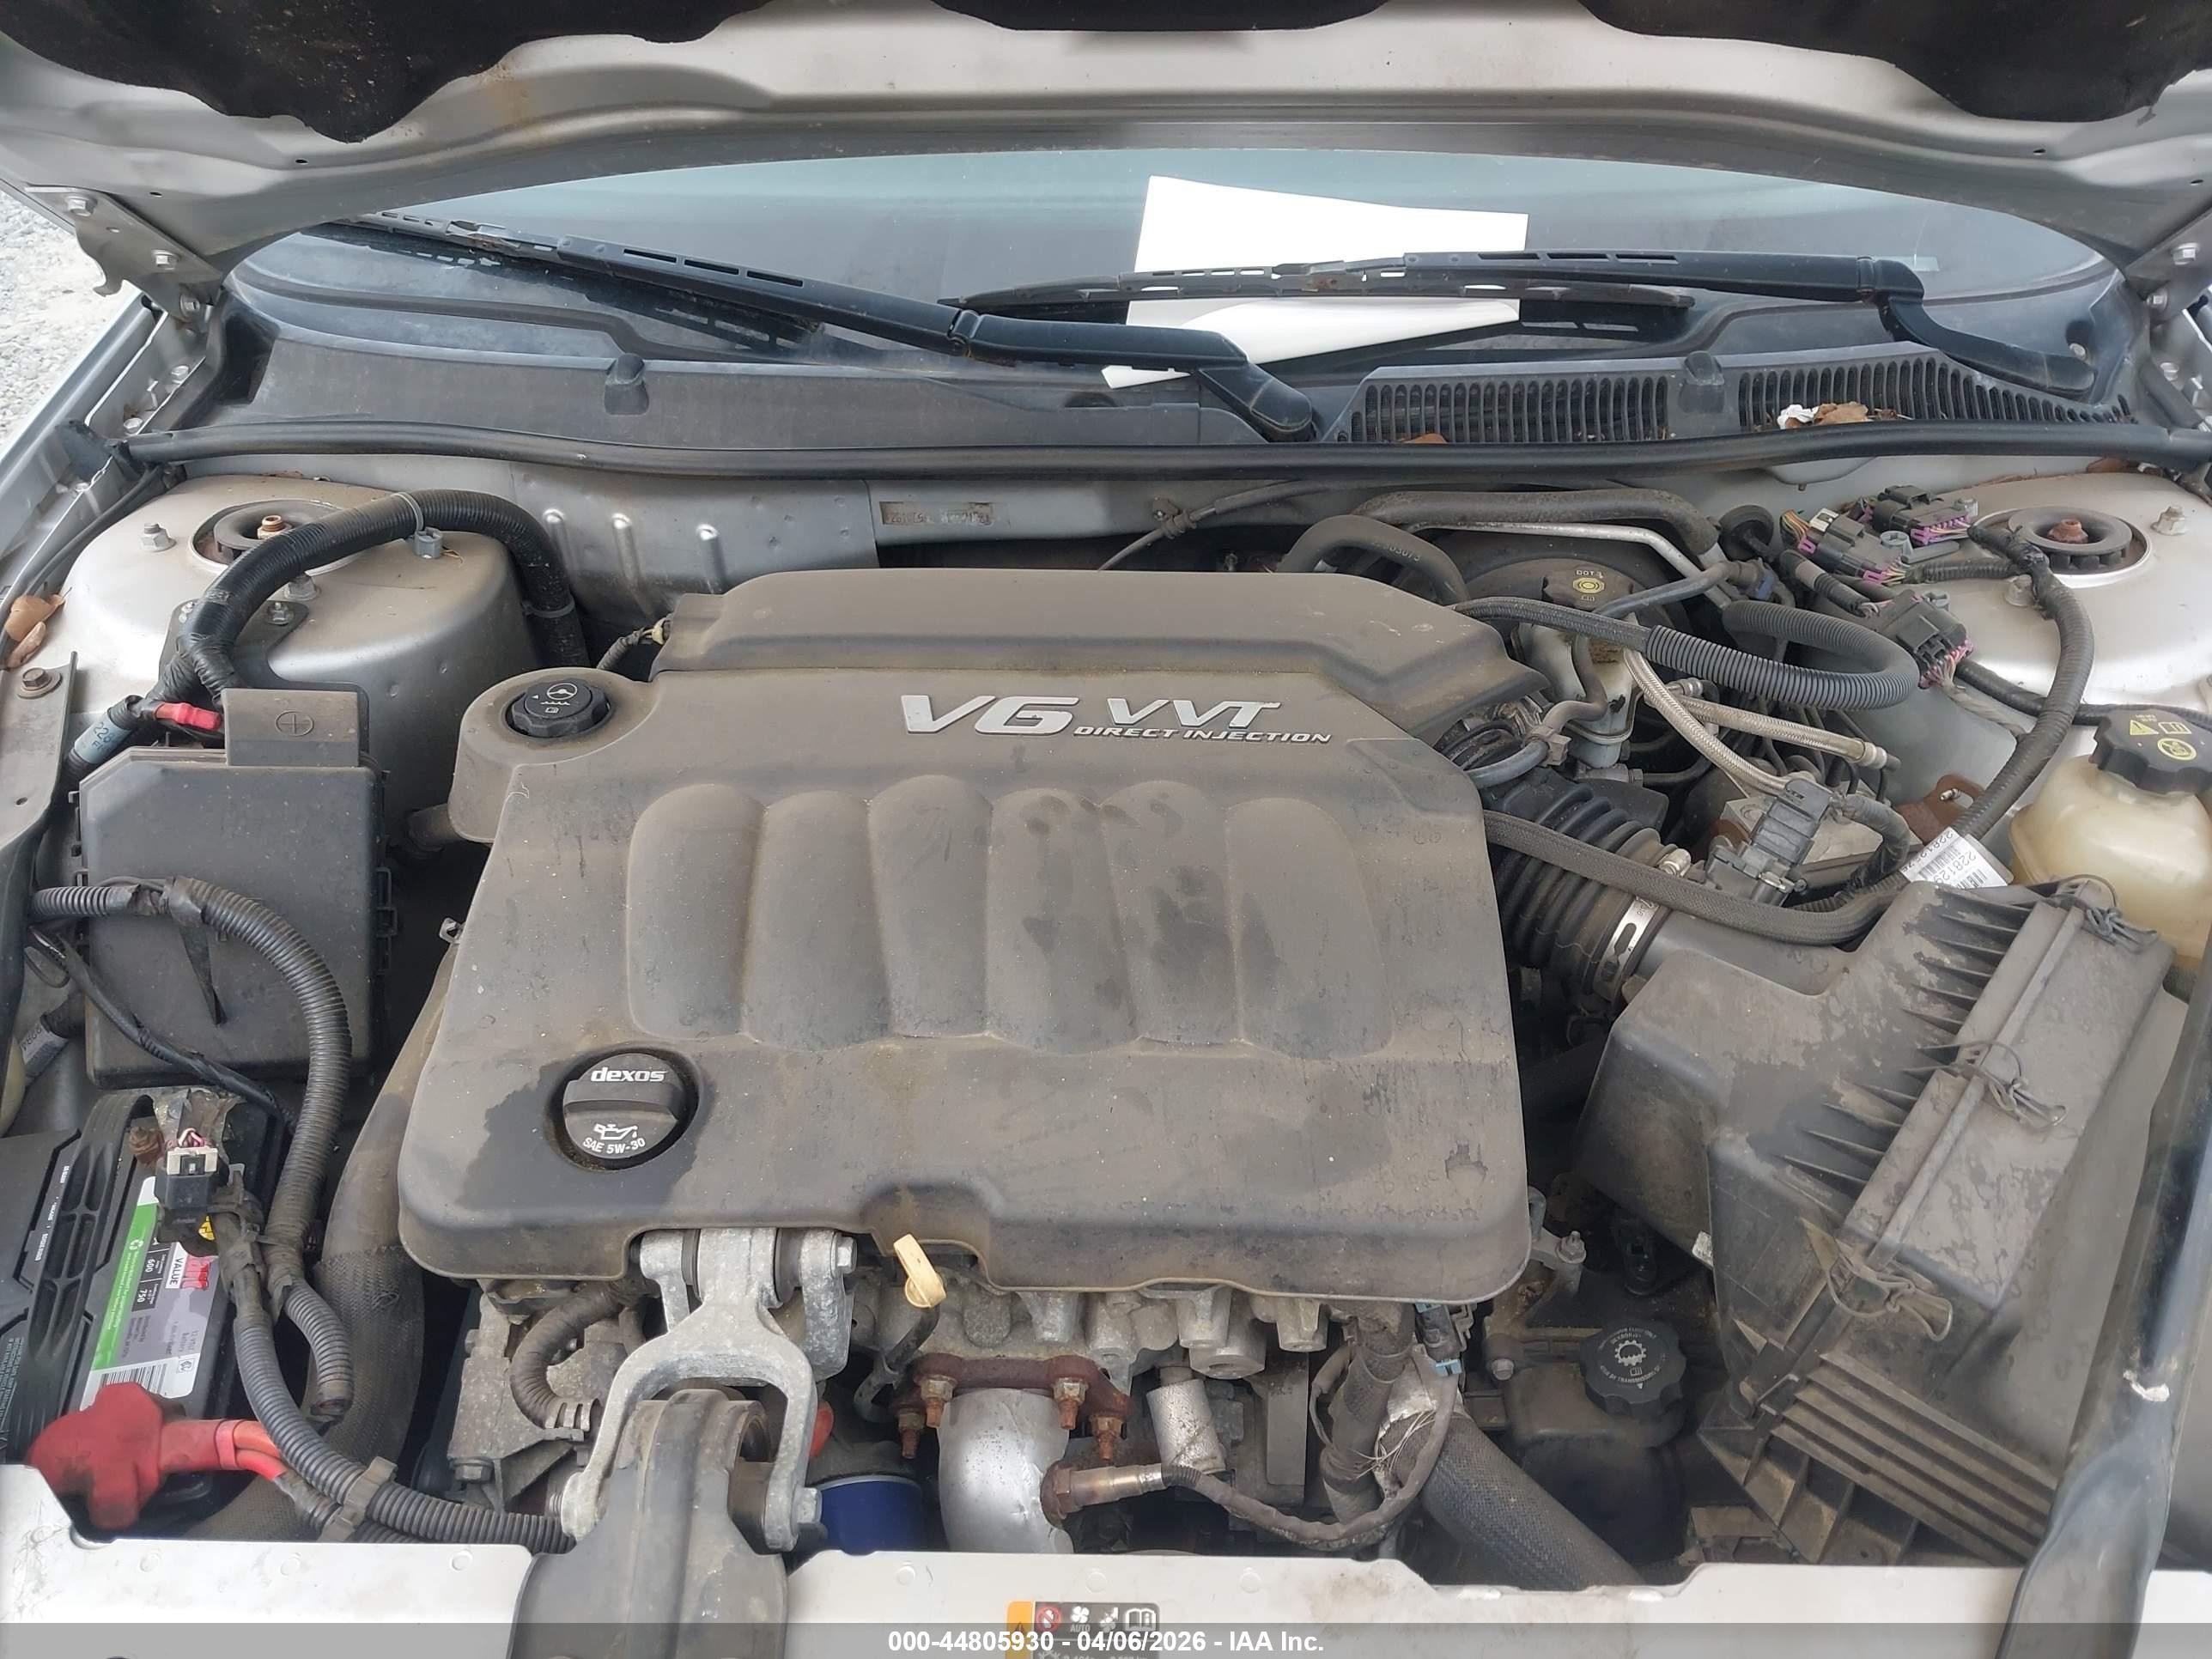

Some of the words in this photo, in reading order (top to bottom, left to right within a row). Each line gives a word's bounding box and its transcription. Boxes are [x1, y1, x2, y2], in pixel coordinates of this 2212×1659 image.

[901, 694, 1080, 736] V6
[1106, 697, 1281, 729] VVT
[1073, 726, 1179, 739] DIRECT
[1182, 729, 1332, 744] INJECTION
[590, 1066, 668, 1083] dexos
[582, 1137, 605, 1153] SAE
[605, 1137, 647, 1155] 5W-30
[145, 1258, 155, 1273] 600
[169, 1256, 185, 1286] VALUE
[137, 1289, 148, 1303] 750
[1070, 1624, 1091, 1632] AUTO
